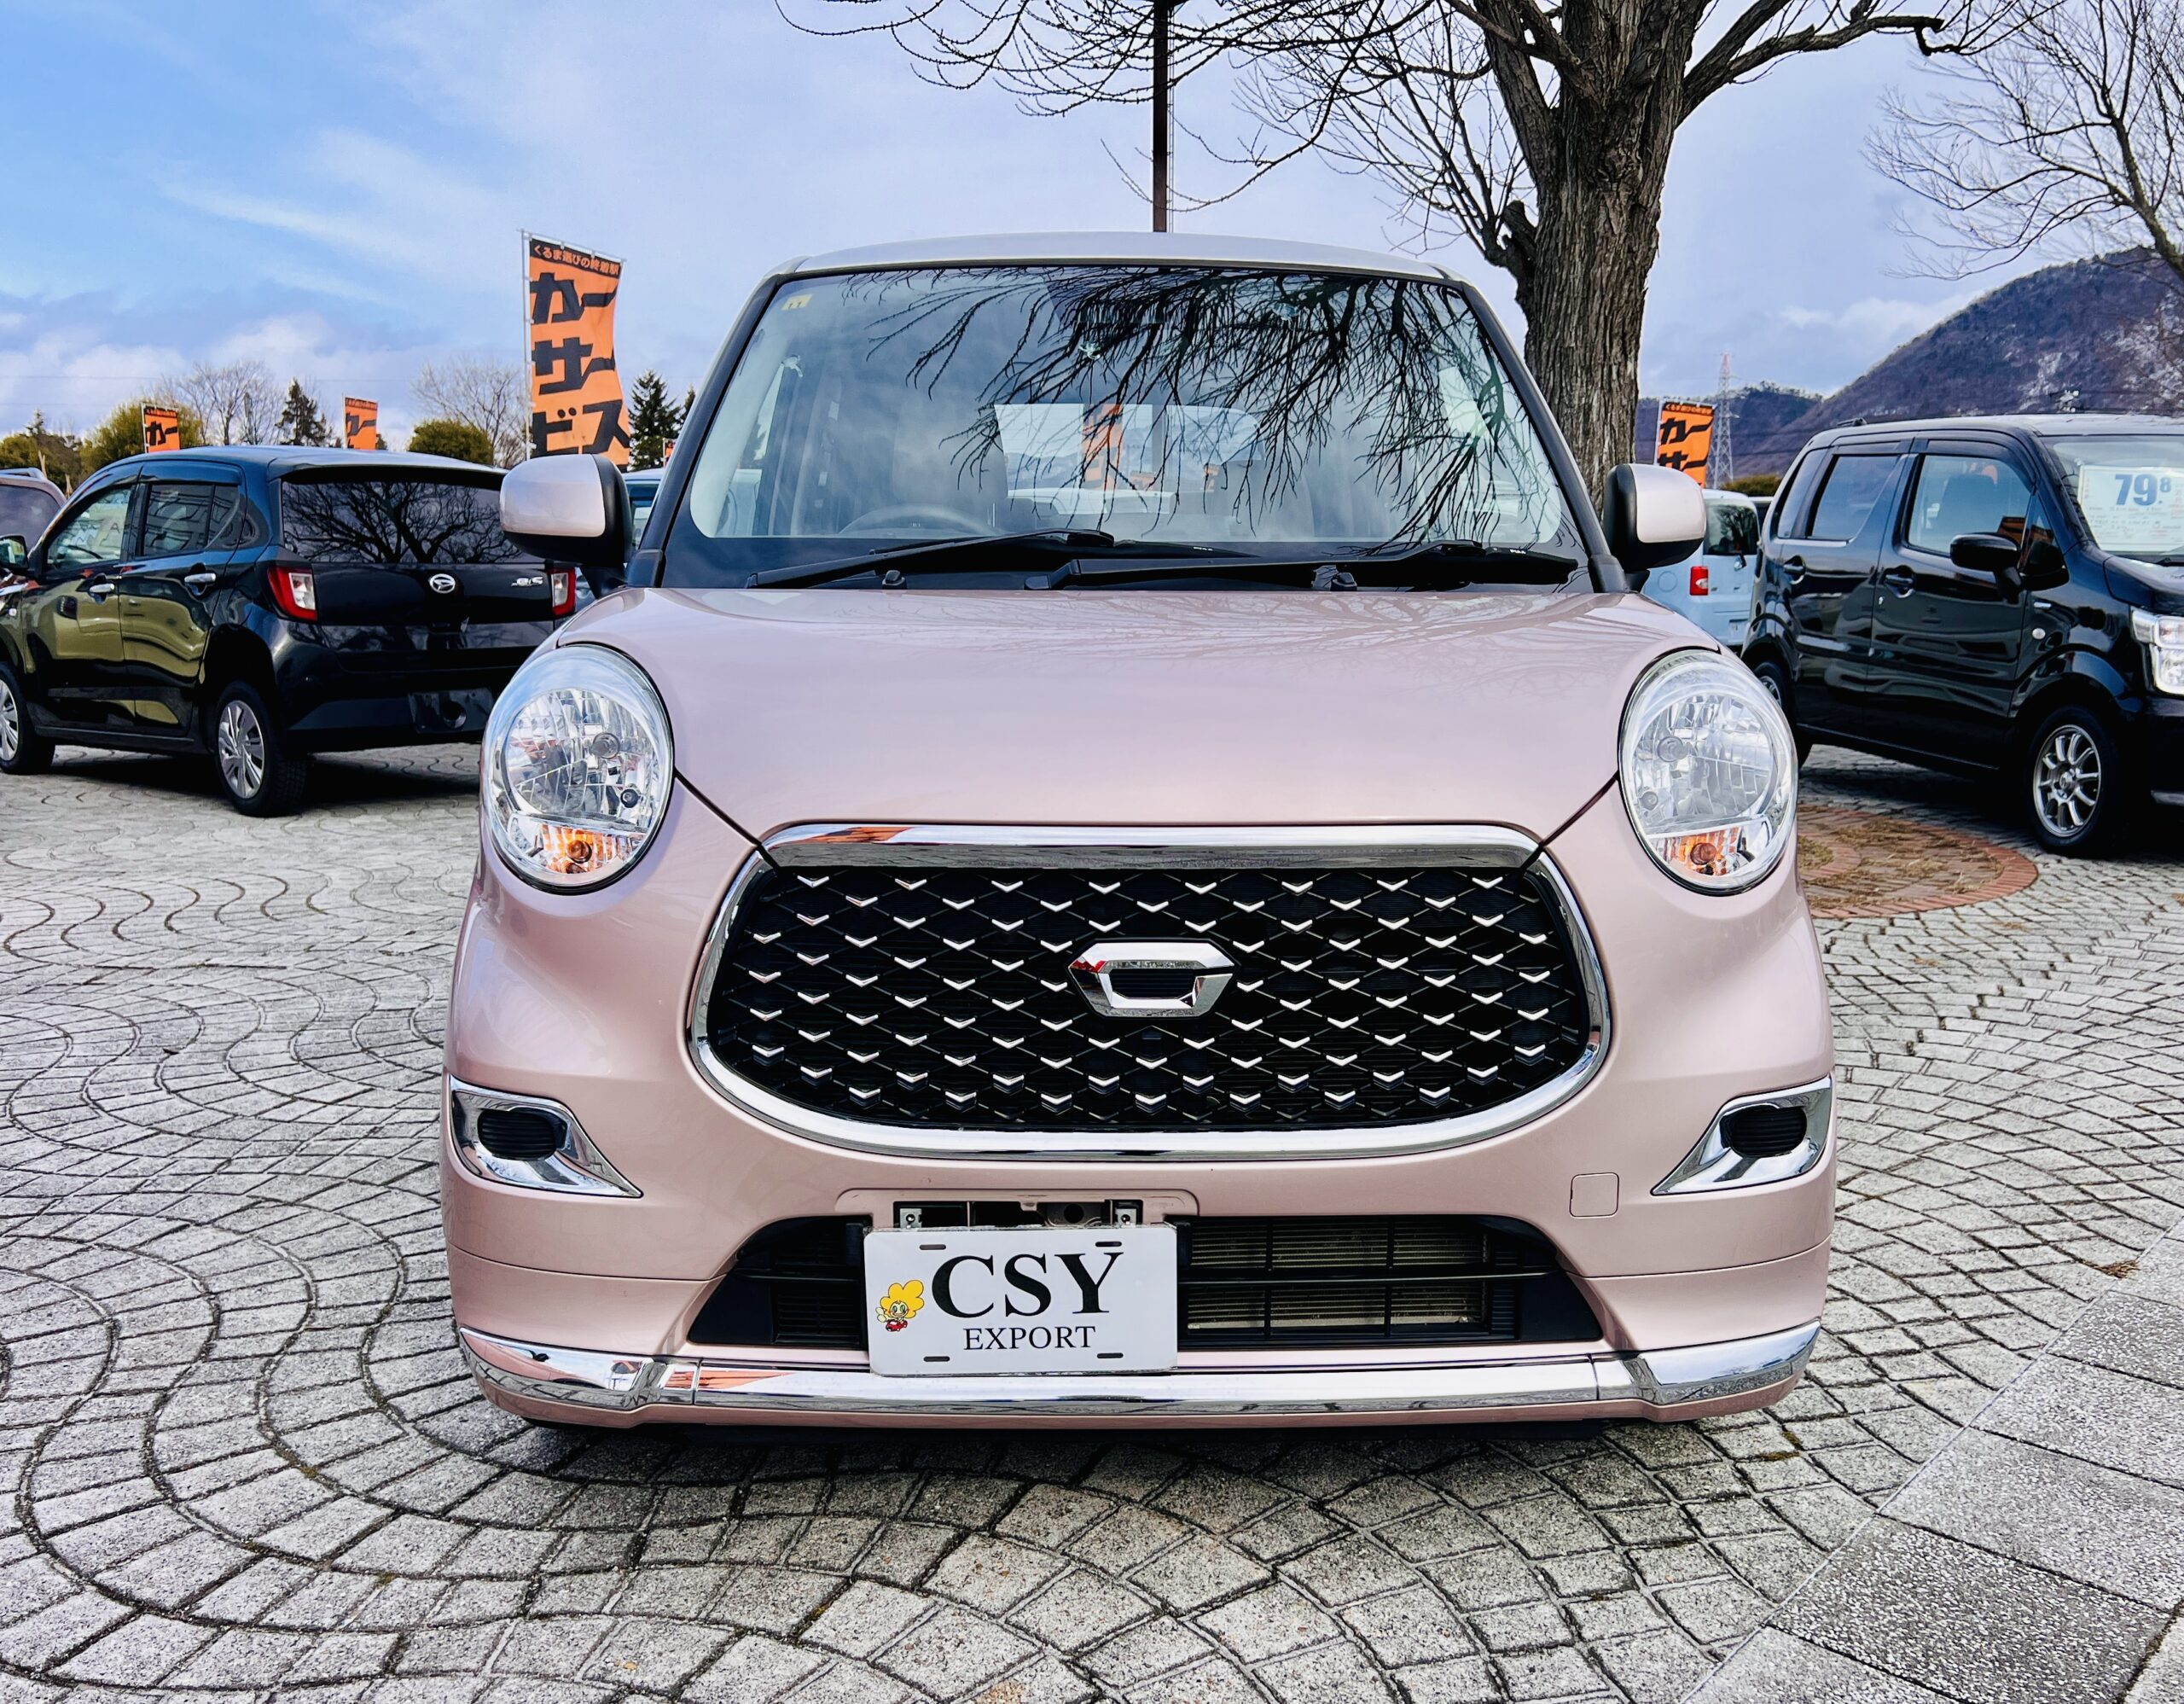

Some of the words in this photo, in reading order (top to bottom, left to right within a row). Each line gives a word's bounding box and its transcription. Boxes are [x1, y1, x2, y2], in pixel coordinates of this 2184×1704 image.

[534, 245, 619, 275] くるま選びの終着駅
[529, 272, 617, 324] カー
[531, 337, 615, 395] サー
[145, 421, 177, 445] カー
[531, 399, 631, 456] ビス
[1660, 417, 1714, 445] カー
[932, 1252, 1124, 1318] CSY
[963, 1326, 1095, 1350] EXPORT
